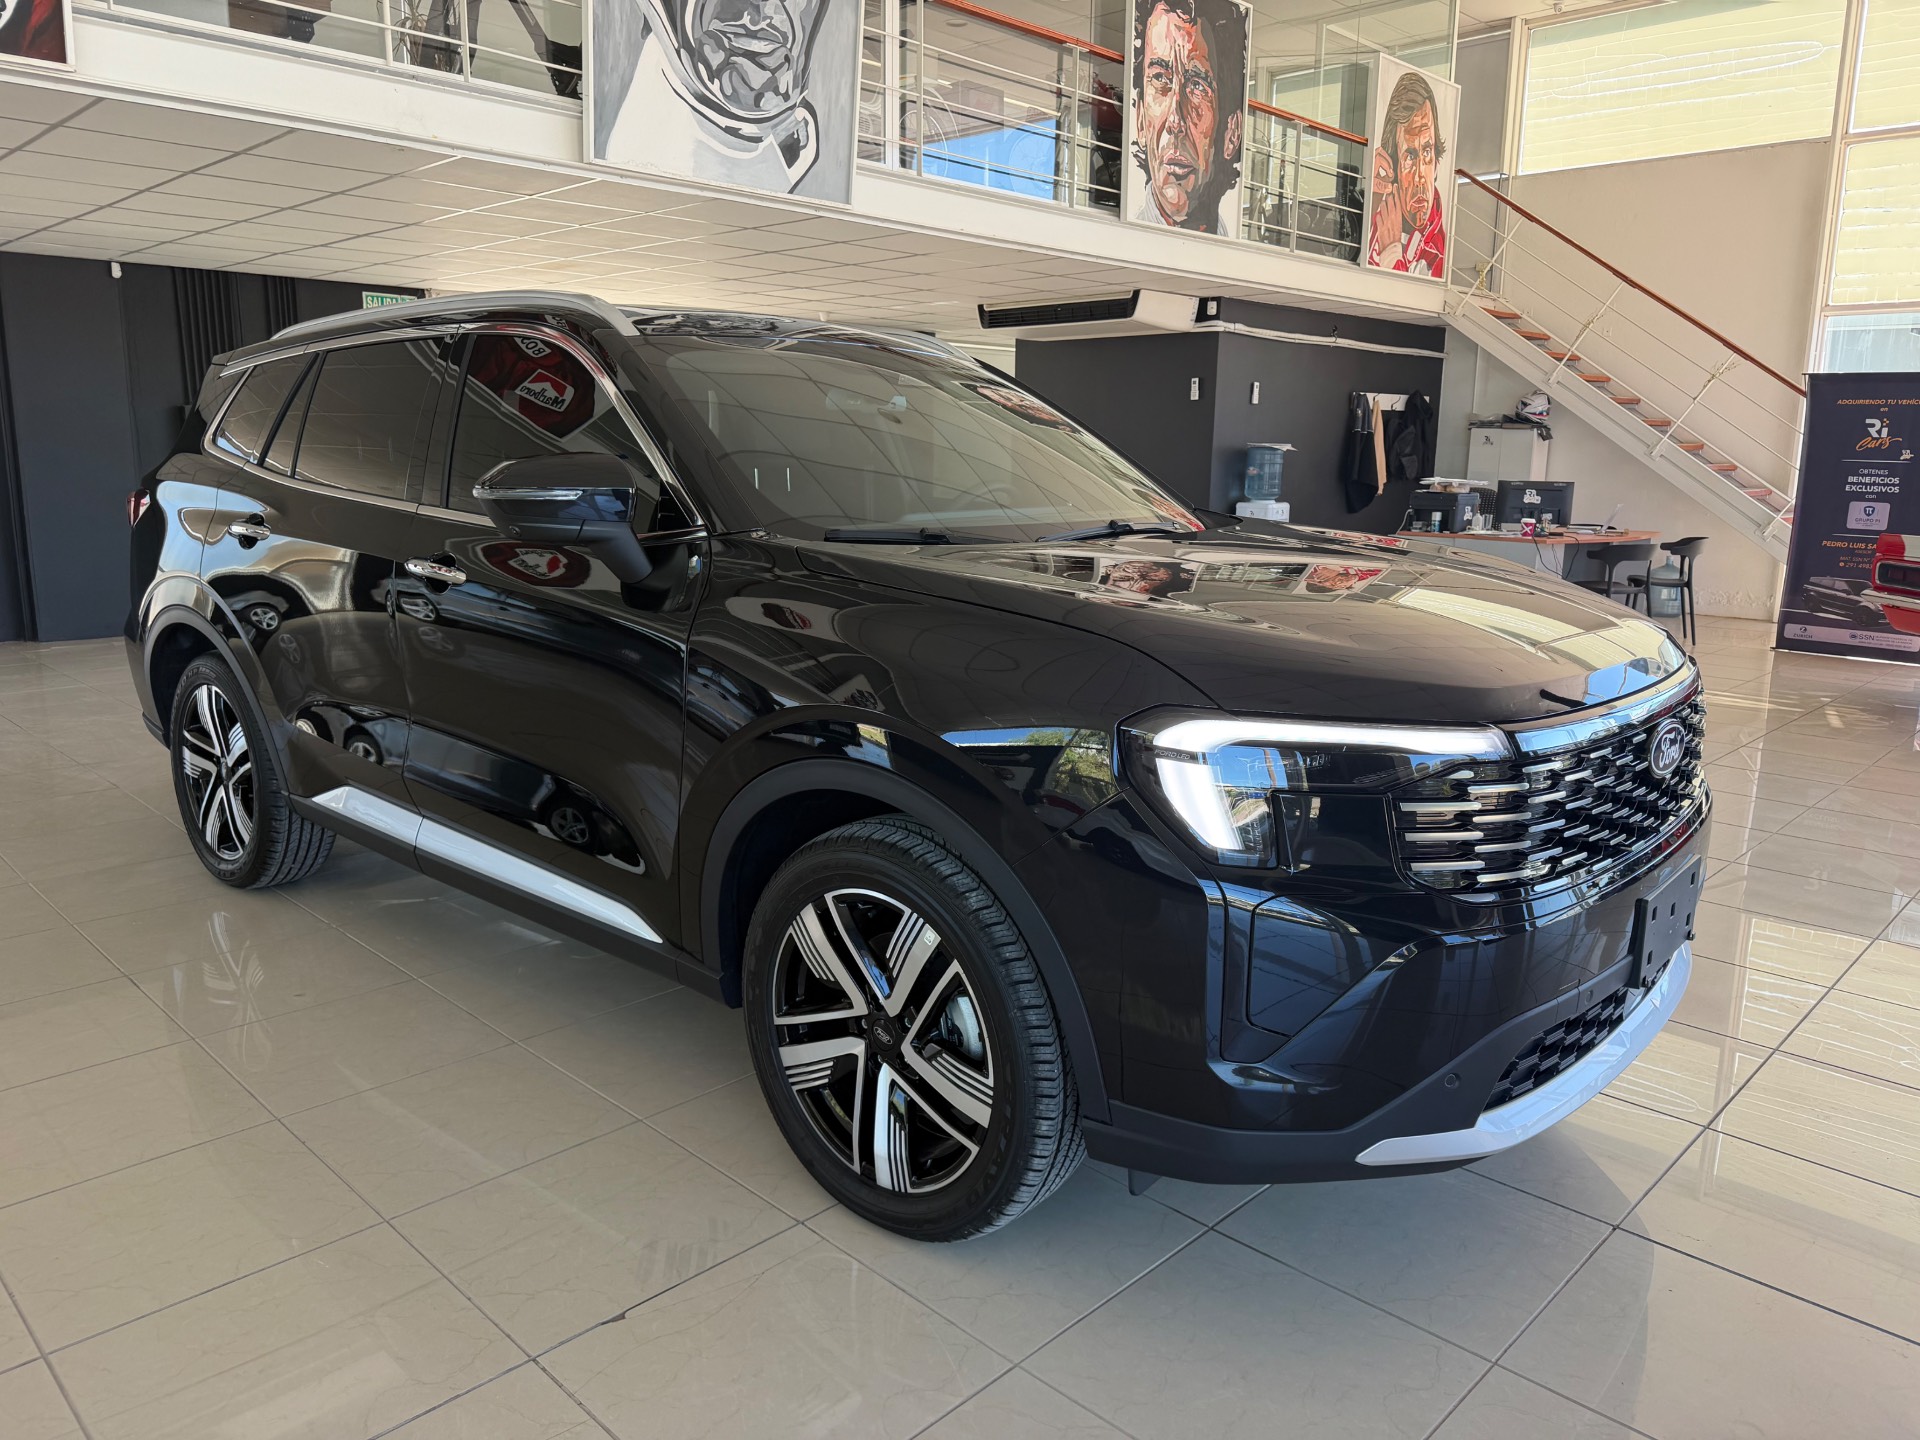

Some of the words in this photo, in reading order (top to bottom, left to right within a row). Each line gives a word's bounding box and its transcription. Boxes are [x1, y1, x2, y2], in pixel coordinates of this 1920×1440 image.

[1865, 417, 1890, 438] Ri
[1855, 436, 1903, 451] Cars
[1847, 475, 1900, 484] BENEFICIOS
[1845, 484, 1900, 493] EXCLUSIVOS
[1821, 540, 1848, 548] PEDRO
[1858, 633, 1875, 641] SSN
[1154, 749, 1177, 758] FORD
[1659, 731, 1683, 768] Ford
